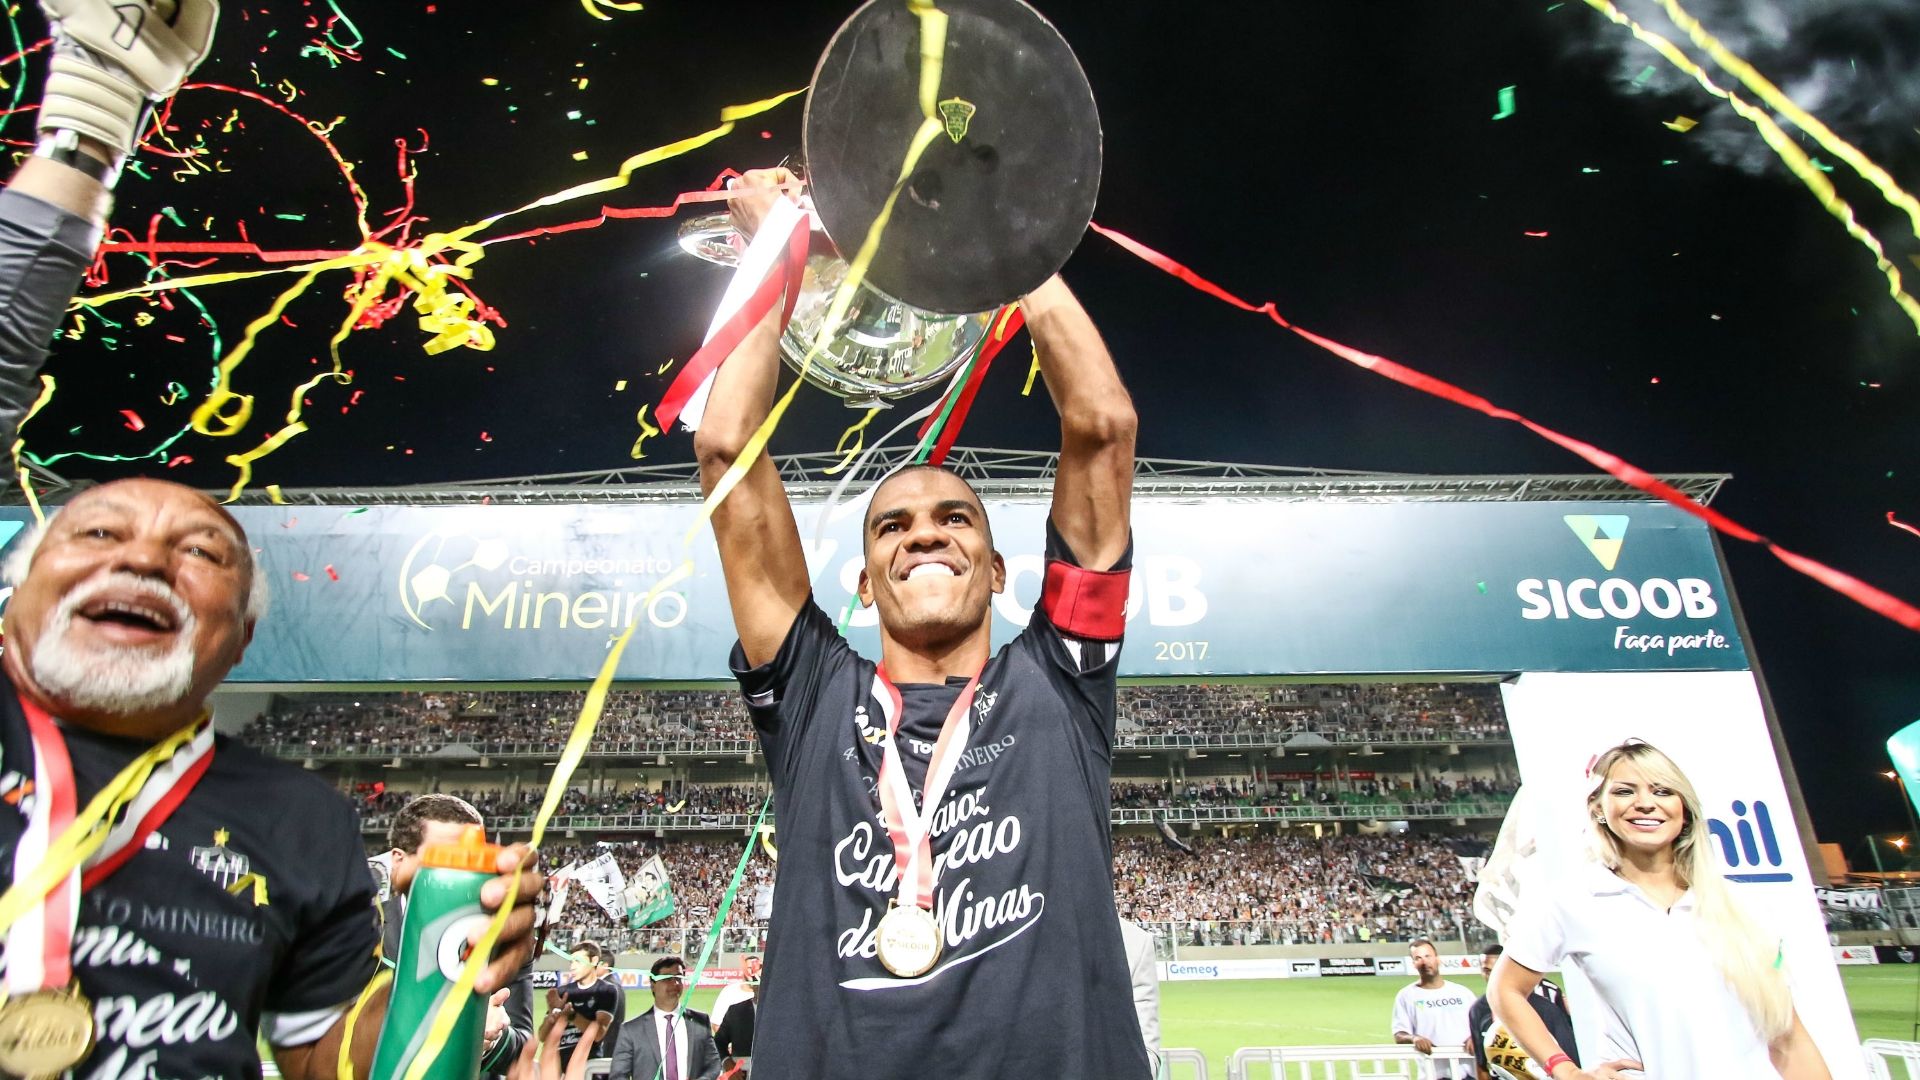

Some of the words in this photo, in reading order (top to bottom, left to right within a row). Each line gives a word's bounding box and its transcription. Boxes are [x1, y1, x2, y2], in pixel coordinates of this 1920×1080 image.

[509, 556, 672, 577] Campeonato
[462, 579, 688, 630] Mineiro
[1516, 577, 1718, 620] SICOOB
[1154, 641, 1209, 661] 2017
[1614, 625, 1665, 653] Faça
[1668, 628, 1730, 657] parte.
[141, 903, 267, 946] MINEIRO
[934, 878, 1034, 947] Minas
[1426, 997, 1463, 1009] SICOOB
